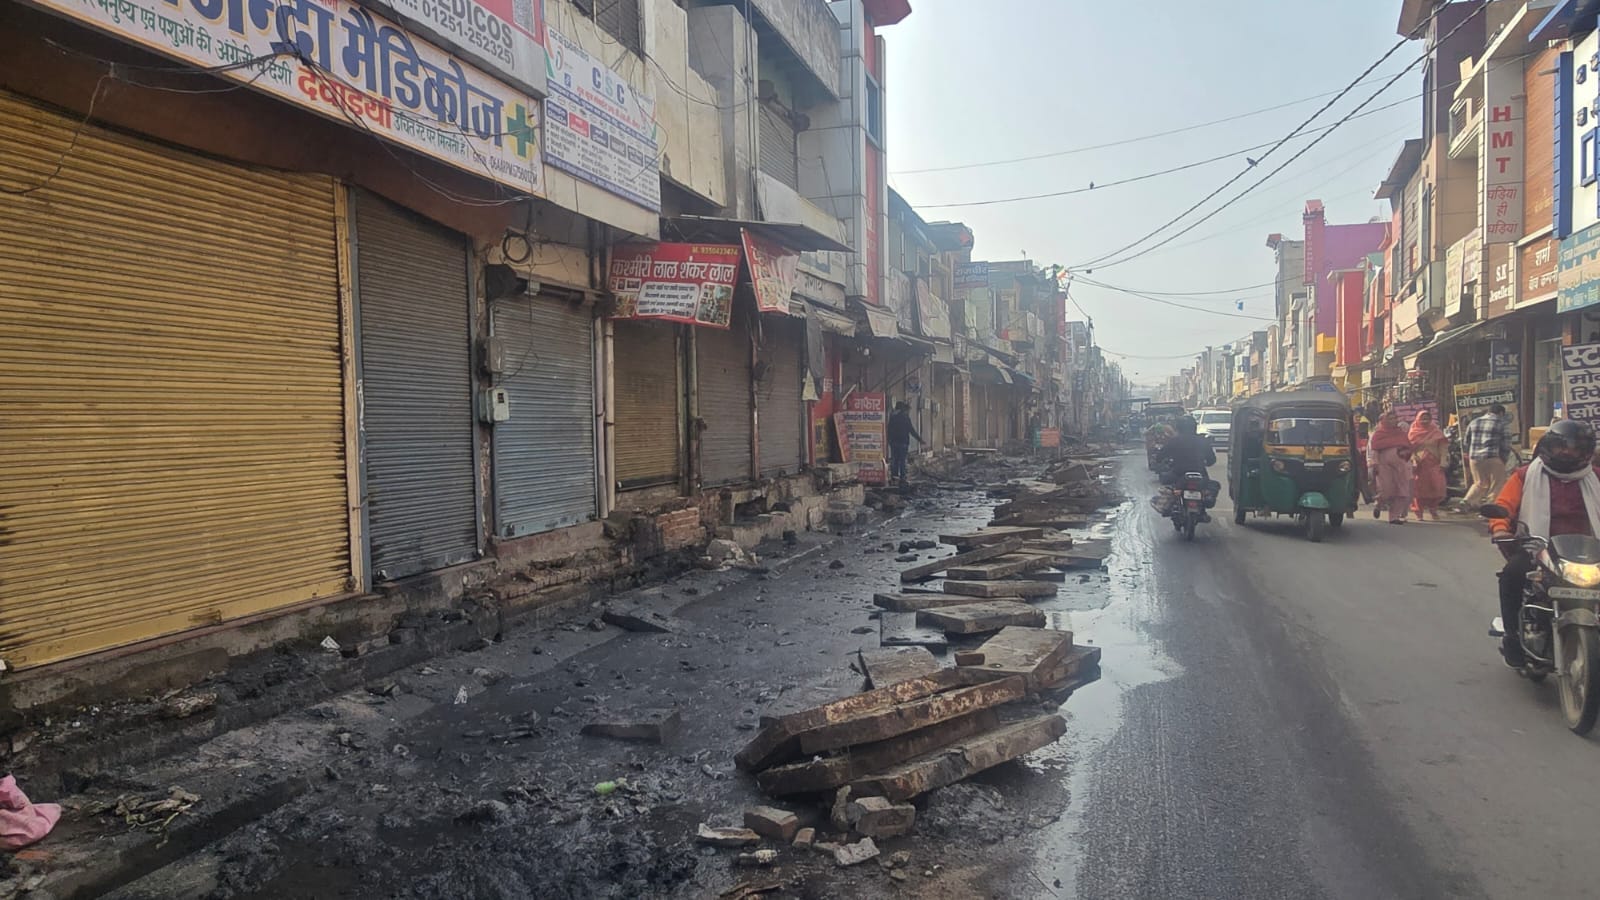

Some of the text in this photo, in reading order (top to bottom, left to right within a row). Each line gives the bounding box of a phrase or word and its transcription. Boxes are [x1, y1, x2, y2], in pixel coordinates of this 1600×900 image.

[195, 25, 212, 54] की
[653, 260, 679, 279] लाल
[680, 255, 709, 279] शंकर
[709, 262, 737, 283] लाल
